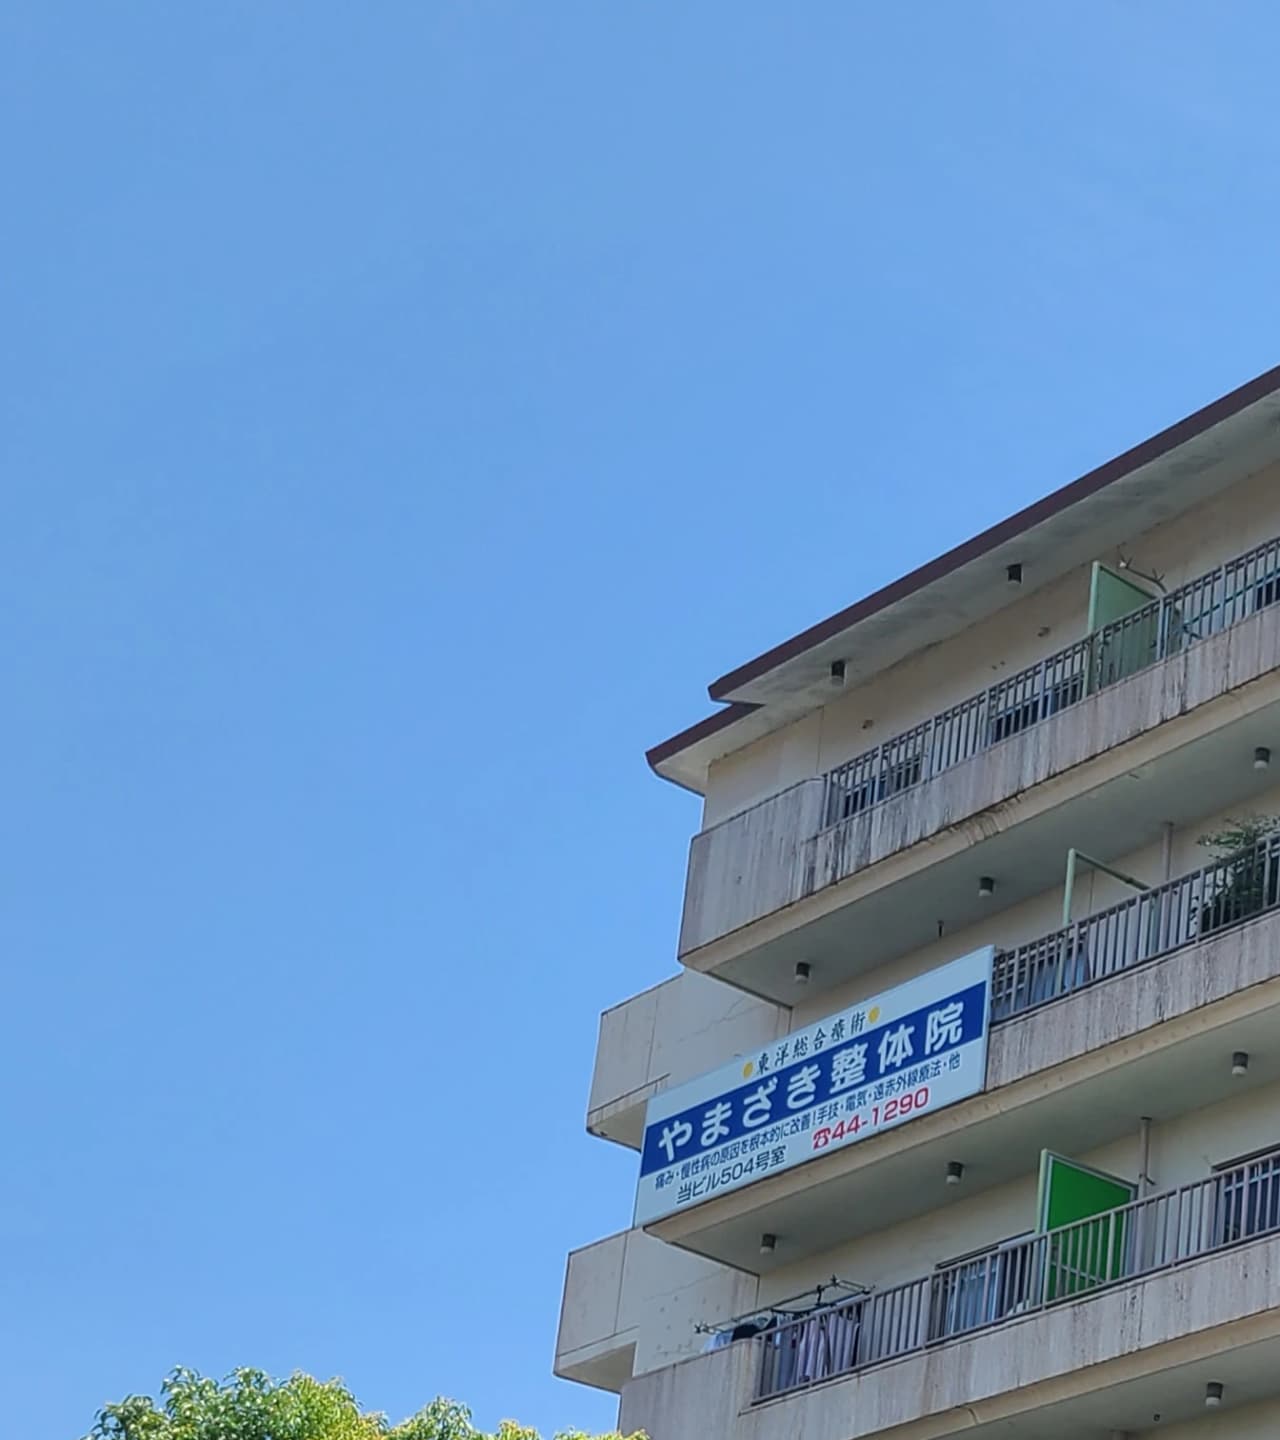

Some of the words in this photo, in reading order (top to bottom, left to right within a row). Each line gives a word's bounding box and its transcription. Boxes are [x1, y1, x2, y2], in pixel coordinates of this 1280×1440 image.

[757, 1012, 866, 1074] 東洋総合療術
[657, 1001, 965, 1162] やまざき整体院
[676, 1145, 787, 1204] 当ビル504号室
